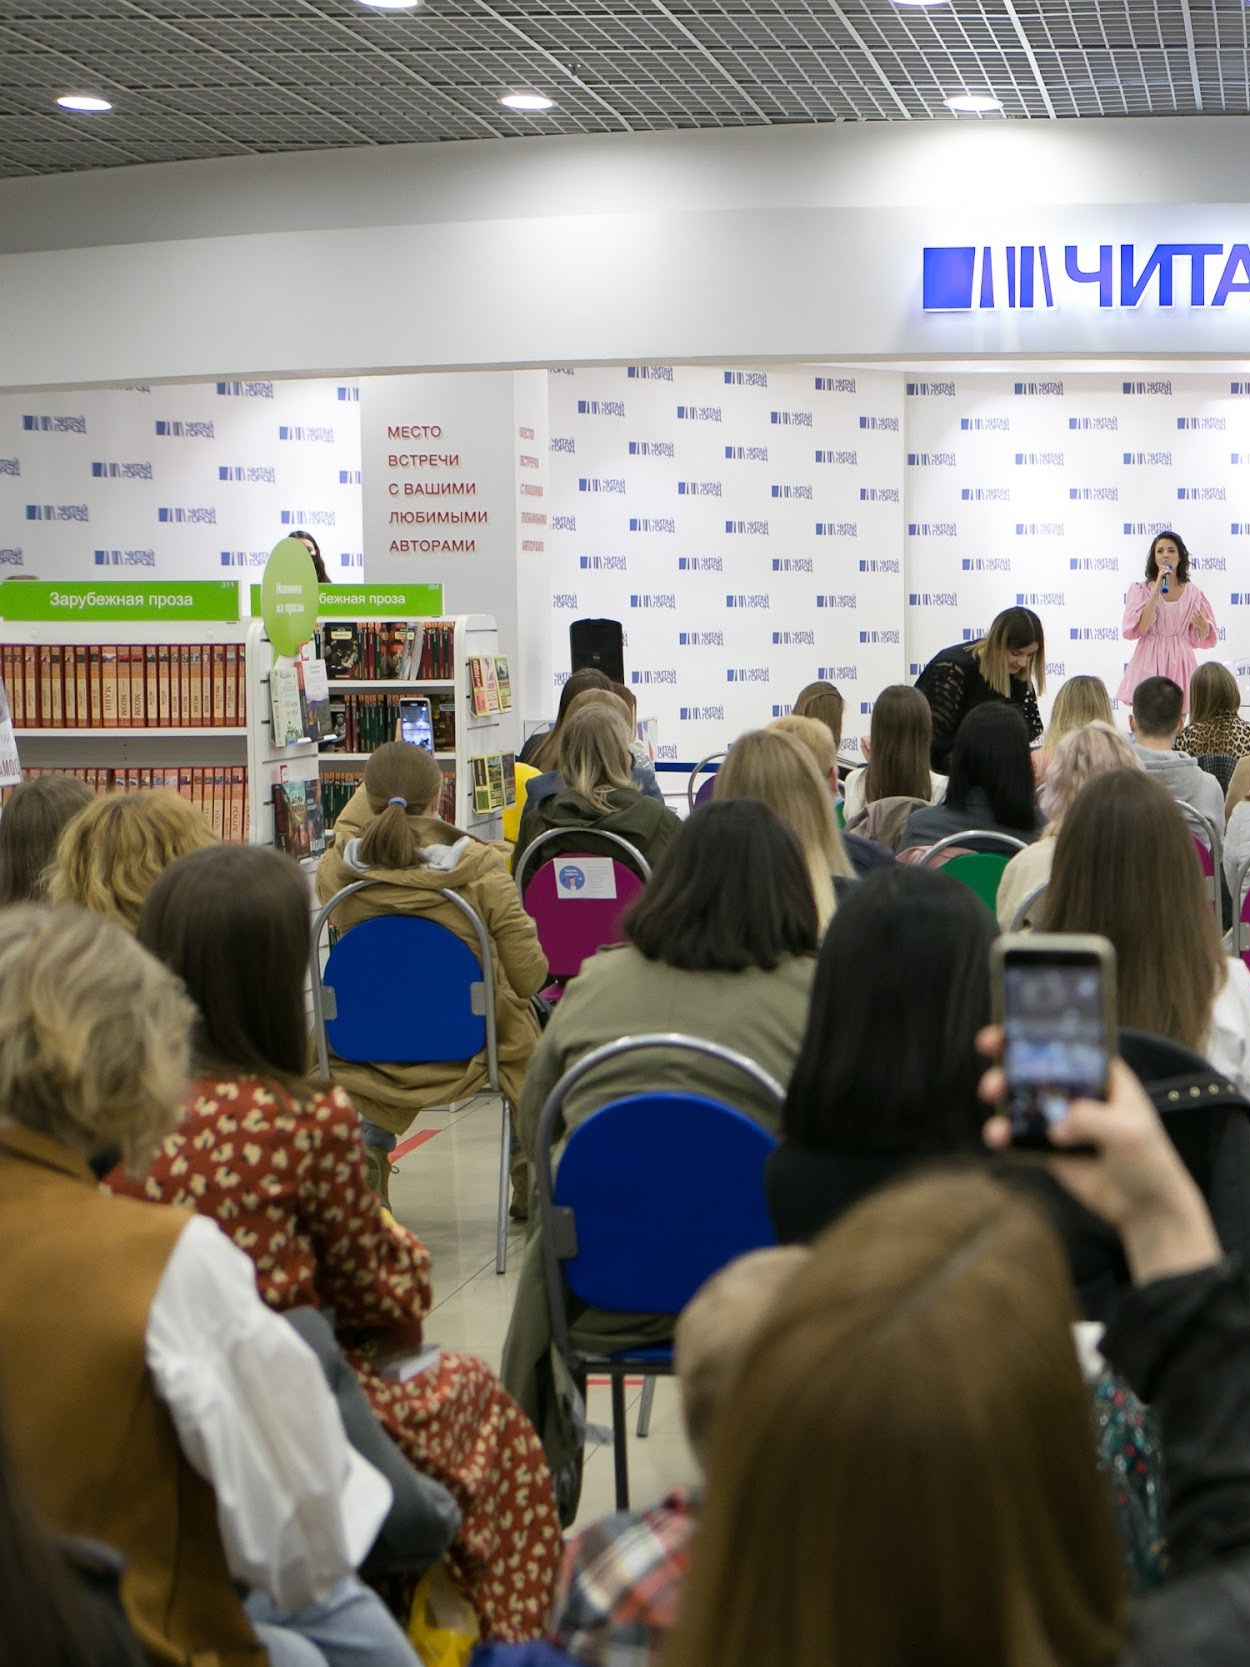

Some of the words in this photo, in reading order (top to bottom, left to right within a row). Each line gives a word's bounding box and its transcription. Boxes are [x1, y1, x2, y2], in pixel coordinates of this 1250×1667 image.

[387, 425, 442, 439] МЕСТО
[388, 454, 460, 468] ВСТРЕЧИ
[388, 482, 399, 496] С
[404, 482, 477, 496] ВАШИМИ
[388, 511, 488, 525] ЛЮБИМЫМИ
[389, 539, 476, 553] АВТОРАМИ
[49, 591, 144, 609] Зарубежная
[149, 595, 193, 609] проза
[319, 592, 366, 605] бежная
[369, 594, 406, 607] проза
